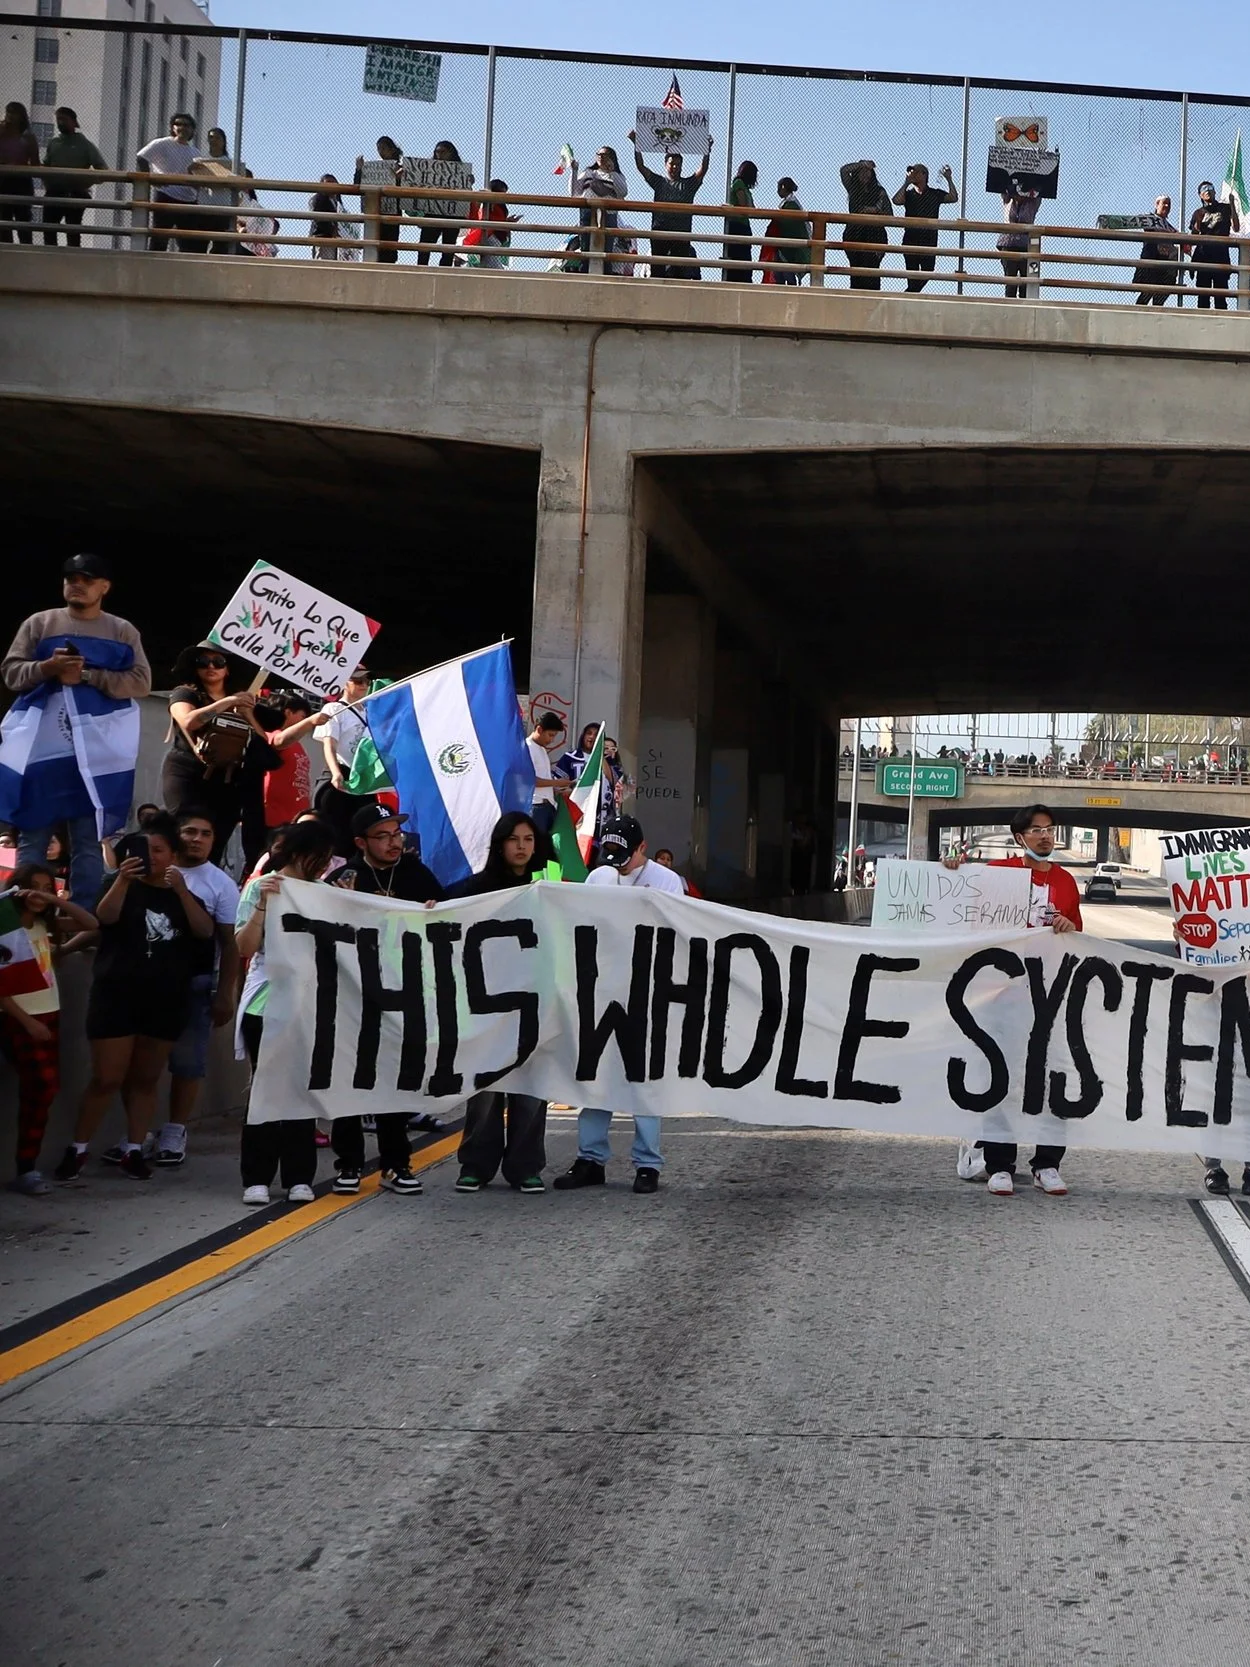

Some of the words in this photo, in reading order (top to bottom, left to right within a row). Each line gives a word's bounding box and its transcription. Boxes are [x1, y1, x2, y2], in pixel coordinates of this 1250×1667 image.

[249, 572, 296, 609] Grito
[303, 601, 322, 624] Lo
[327, 616, 360, 643] Que
[260, 610, 294, 639] Mi
[298, 628, 348, 668] Gente
[220, 621, 264, 657] Calla
[265, 645, 295, 672] Por
[293, 659, 341, 697] Miedo
[641, 765, 667, 782] SE
[928, 771, 949, 780] Ave
[635, 786, 682, 800] PUEDE
[925, 784, 949, 792] RIGHT
[887, 866, 983, 900] UNIDOS
[888, 900, 937, 923] JAMAS
[1182, 924, 1212, 938] STOP
[1185, 947, 1239, 966] Families
[282, 912, 540, 1098] THIS
[574, 924, 921, 1104] WHOLE
